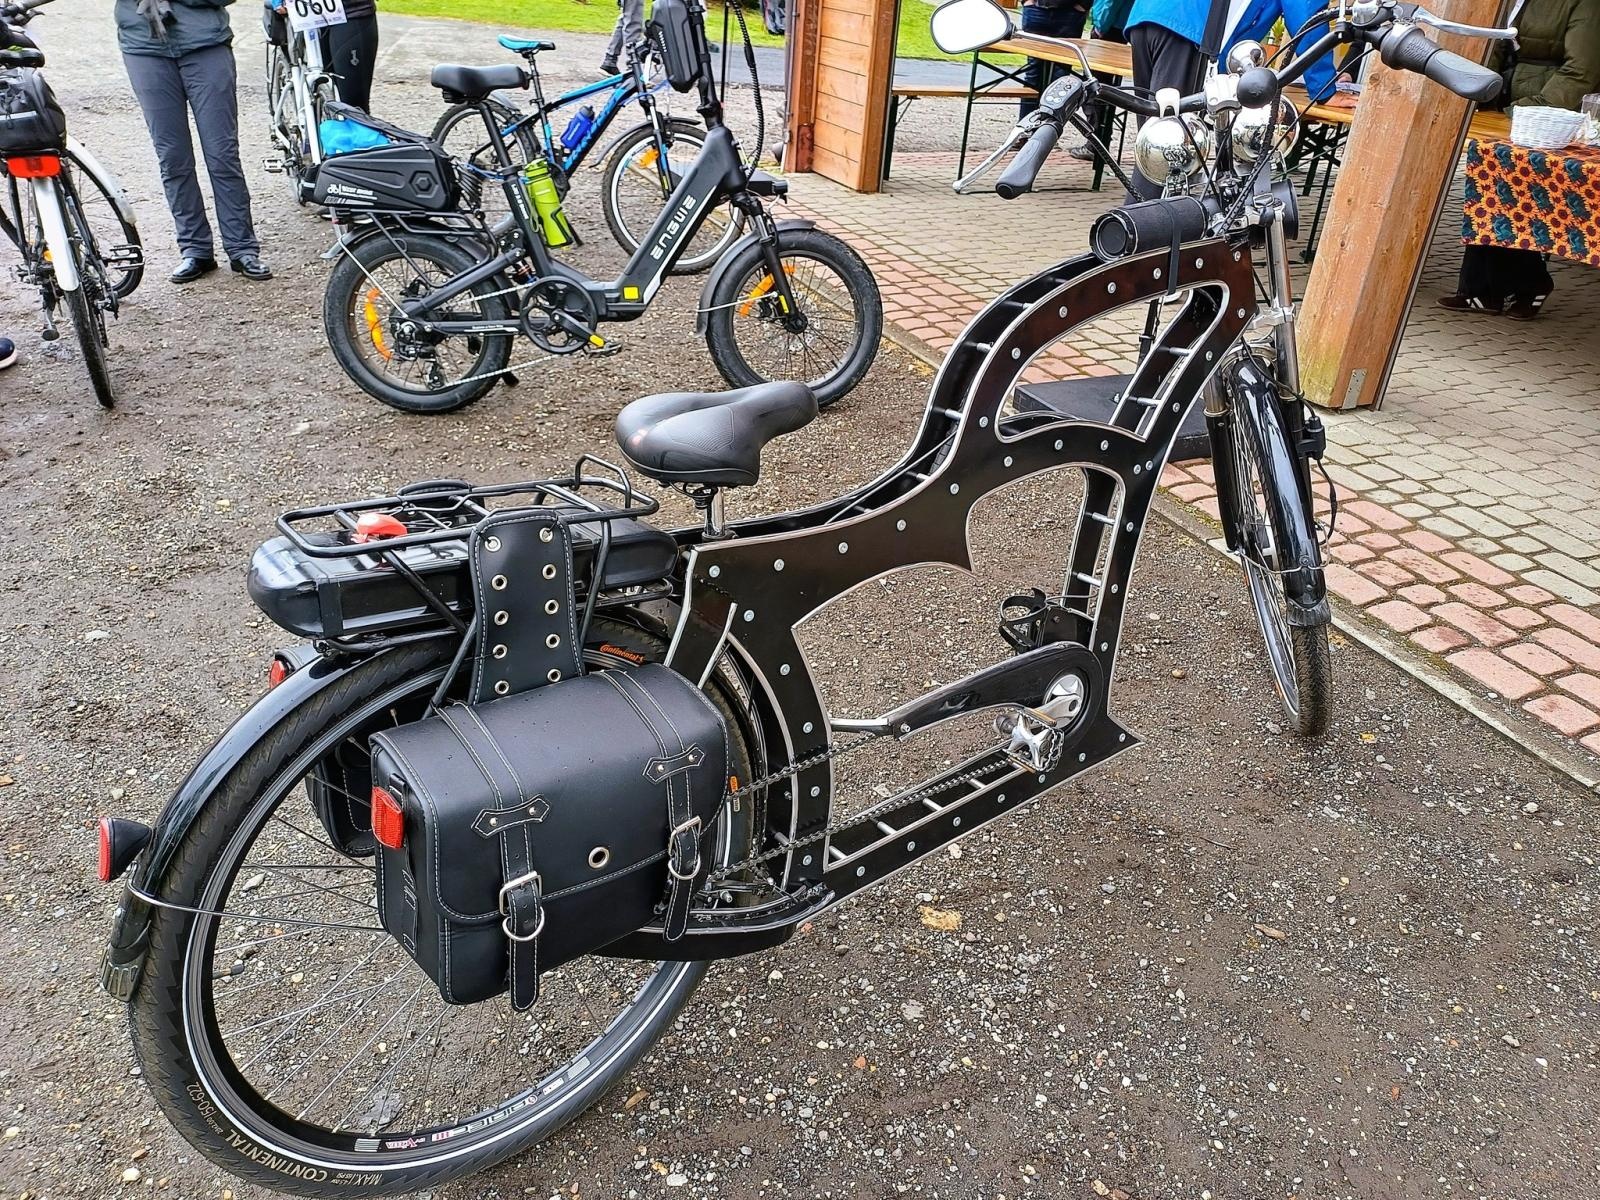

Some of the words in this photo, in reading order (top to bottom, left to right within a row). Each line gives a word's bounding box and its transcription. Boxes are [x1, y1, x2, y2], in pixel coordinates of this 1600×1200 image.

[650, 194, 697, 260] ENGWE
[600, 644, 640, 661] Continental
[186, 1081, 215, 1117] 50-622
[224, 1128, 328, 1183] CONTINENTAL
